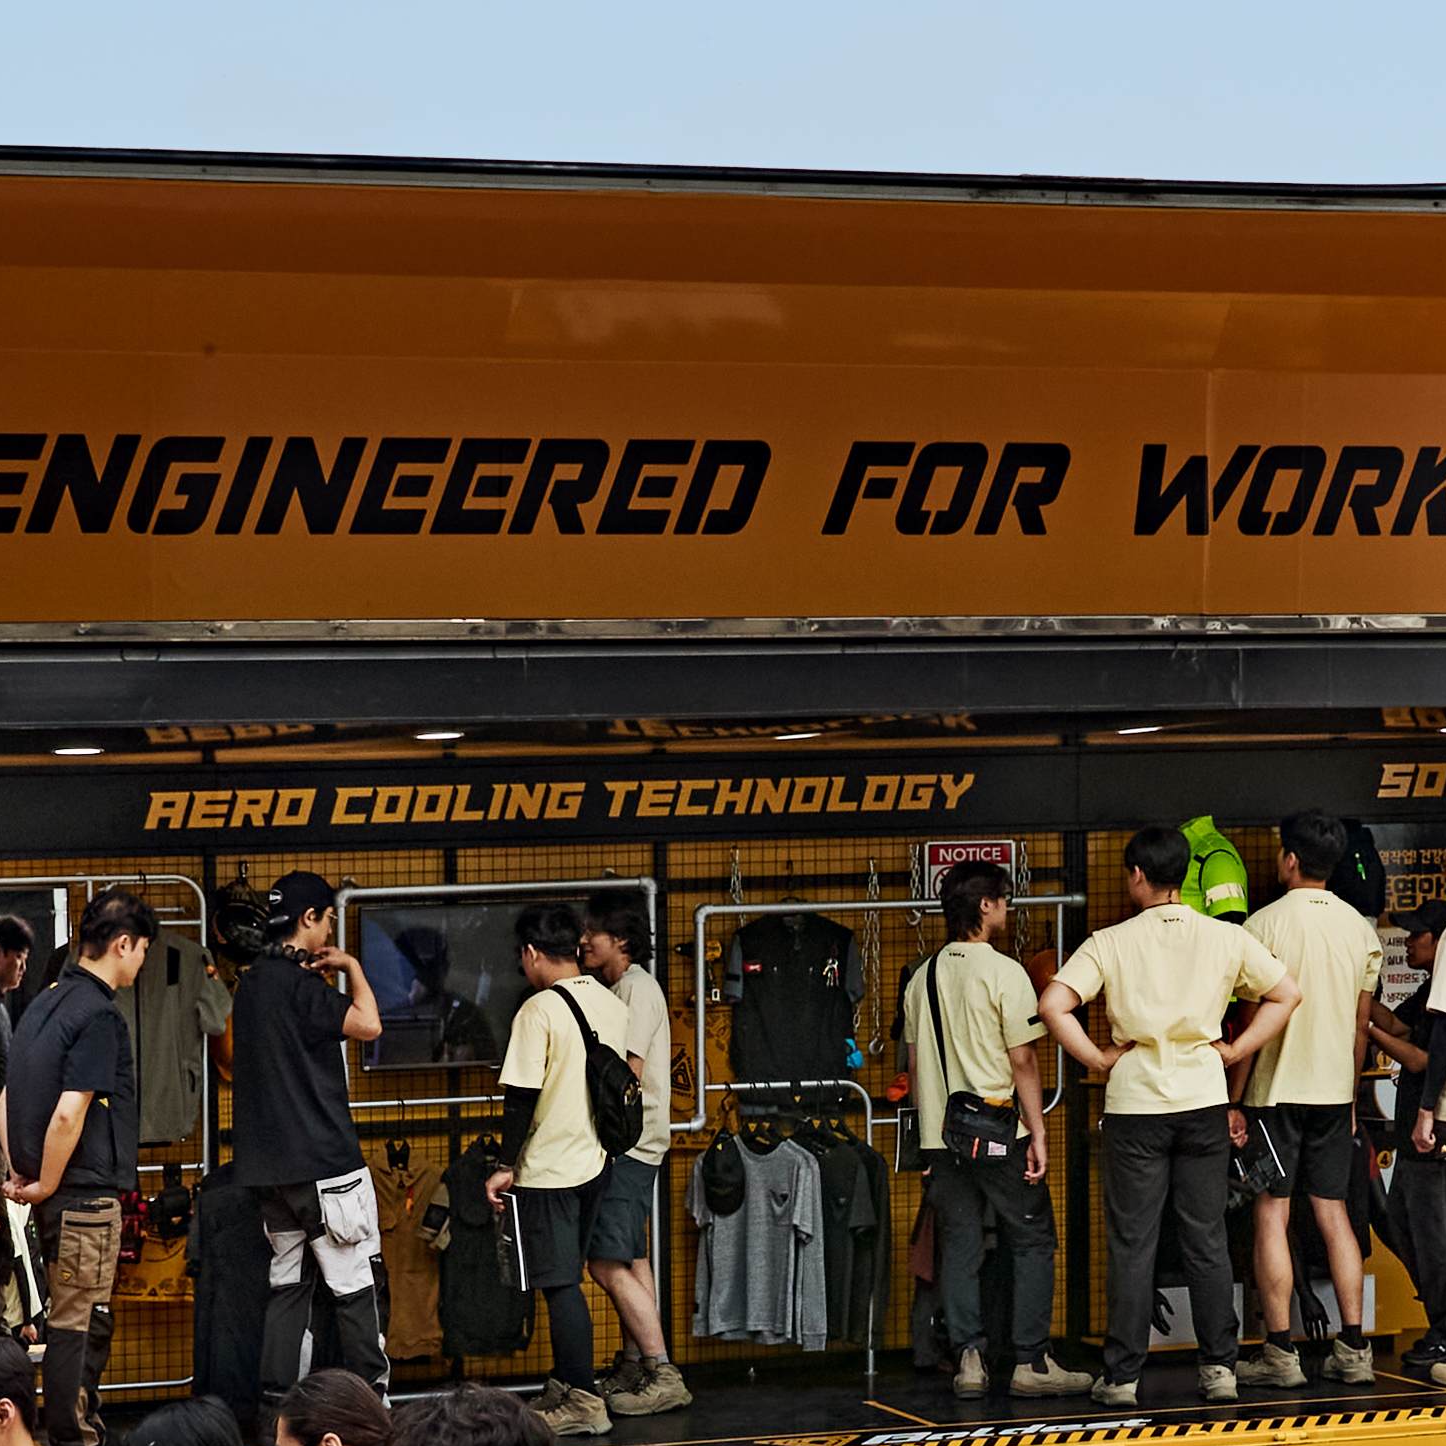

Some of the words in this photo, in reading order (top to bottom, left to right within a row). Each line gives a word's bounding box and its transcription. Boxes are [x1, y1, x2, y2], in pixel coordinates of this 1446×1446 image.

[822, 441, 1070, 535] FOR
[144, 788, 317, 830] AERO
[330, 782, 586, 825] COOLING
[605, 773, 975, 817] TECHNOLOGY
[938, 847, 1002, 862] NOTICE
[861, 1418, 1152, 1446] Boldest
